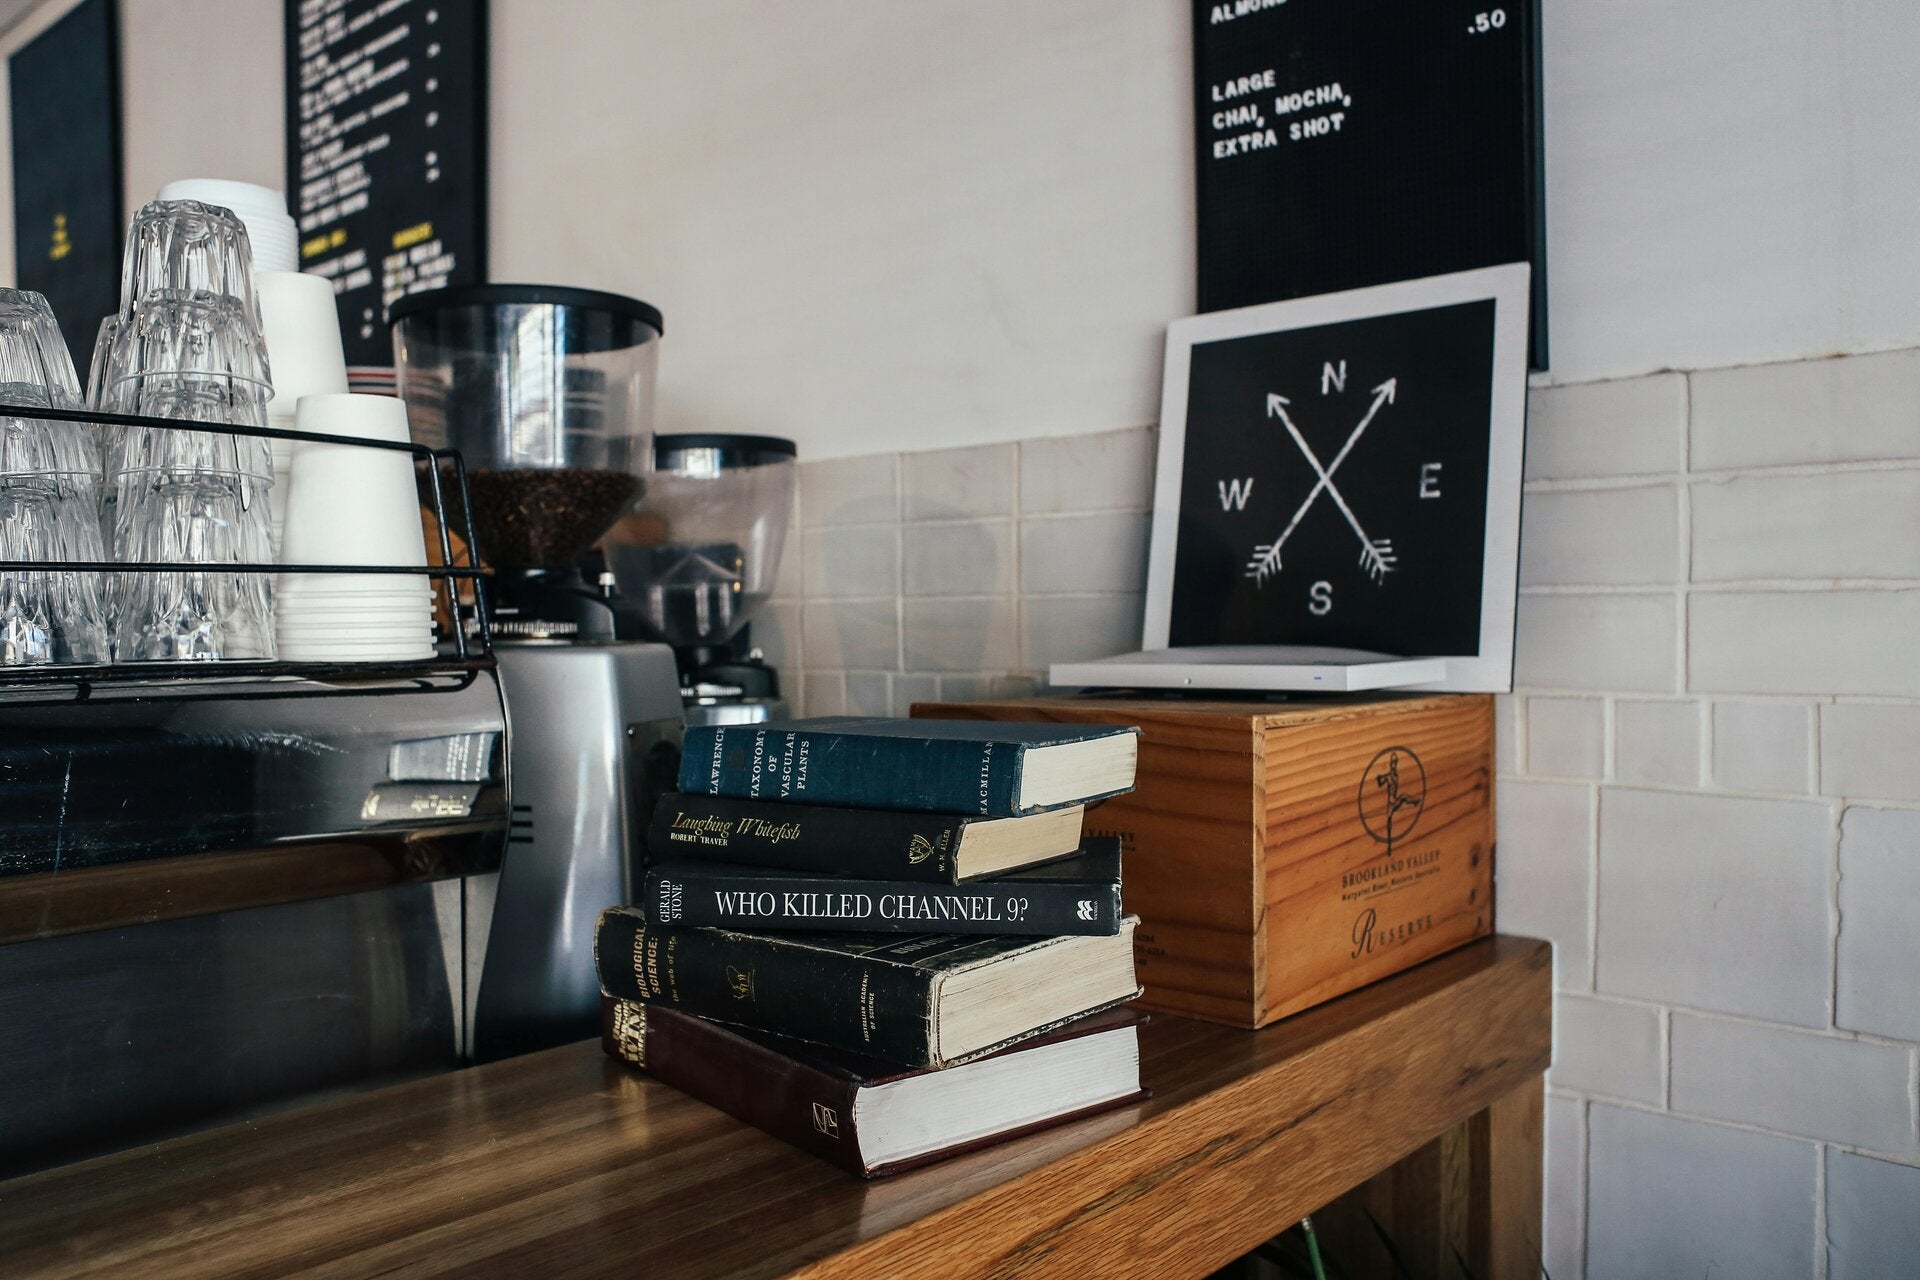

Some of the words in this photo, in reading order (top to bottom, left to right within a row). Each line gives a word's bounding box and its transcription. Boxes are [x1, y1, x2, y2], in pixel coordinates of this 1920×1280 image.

[1210, 0, 1288, 25] ALMO
[1467, 8, 1507, 34] .50
[1212, 69, 1277, 102] LARGE
[1212, 104, 1264, 130] CHAI,
[1274, 82, 1351, 116] MOCHA,
[1212, 128, 1279, 160] EXTRA
[1289, 112, 1345, 142] SHOT
[1321, 359, 1347, 395] N
[1218, 476, 1254, 512] W
[1419, 462, 1443, 499] E
[1308, 580, 1333, 616] S
[709, 726, 726, 796] LAWRENCE
[751, 728, 767, 799] TAXONOMY
[768, 754, 778, 773] OF
[781, 731, 796, 798] VASCULAR
[796, 739, 810, 790] PLANTS
[979, 741, 995, 816] MACMILLAN
[670, 831, 697, 844] ROBERT
[700, 835, 729, 847] TRAVER
[671, 811, 733, 839] Laughing
[736, 816, 801, 844] Whitefish
[1342, 860, 1405, 889] BROOKLAND
[660, 879, 671, 923] GERALD
[672, 883, 683, 920] STONE
[715, 891, 776, 917] WHO
[782, 892, 872, 918] KILLED
[879, 894, 1001, 921] CHANNEL
[1006, 897, 1029, 922] 9?
[633, 926, 651, 999] BIOLOGICAL
[647, 936, 662, 995] SCIENCE:
[666, 968, 676, 985] web
[667, 954, 674, 965] of
[671, 988, 680, 1002] the
[860, 972, 869, 1004] ACADEMY
[861, 1005, 870, 1043] AUSTRALIAN
